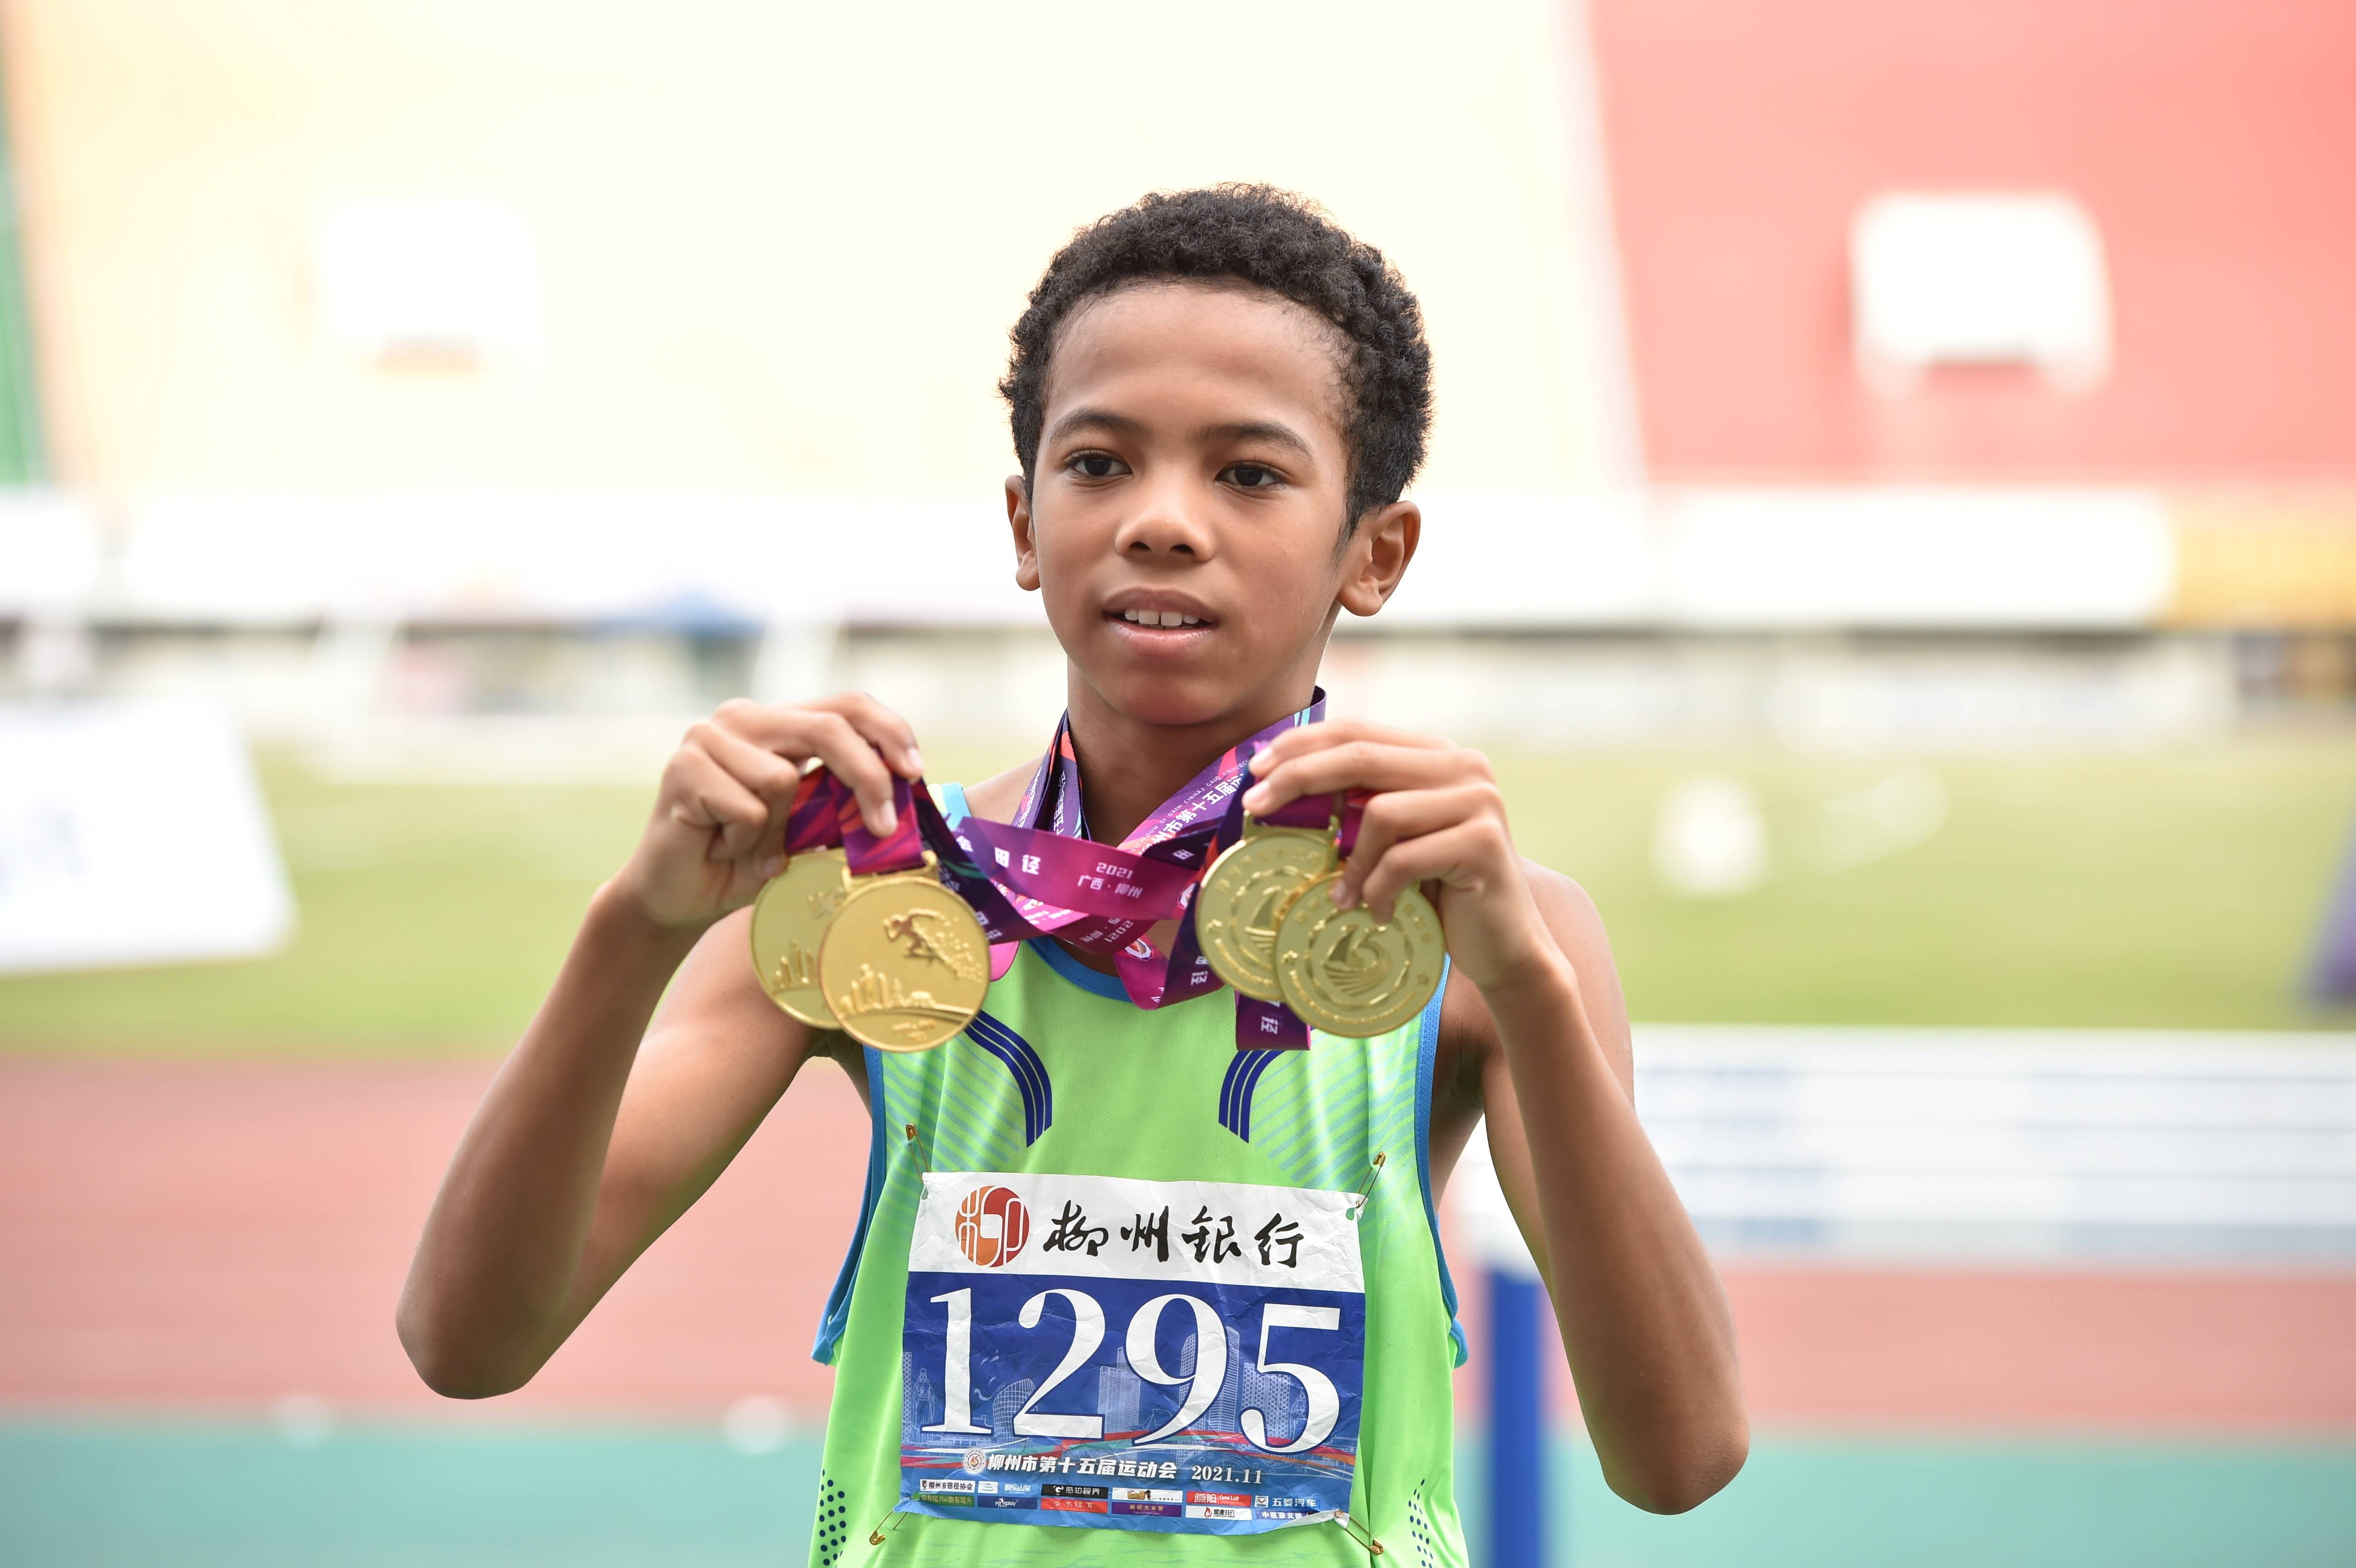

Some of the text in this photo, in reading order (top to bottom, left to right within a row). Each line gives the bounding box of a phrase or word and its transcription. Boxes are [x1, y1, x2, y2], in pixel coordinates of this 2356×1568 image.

[1096, 862, 1134, 879] 2021
[1043, 1199, 1305, 1269] 柳州银行
[921, 1287, 1341, 1453] 1295
[987, 1453, 1177, 1479] 柳州市第十五届运动会
[1191, 1465, 1263, 1484] 2021.11
[1066, 1486, 1100, 1495] 感知视界
[1272, 1497, 1317, 1507] 五菱汽车
